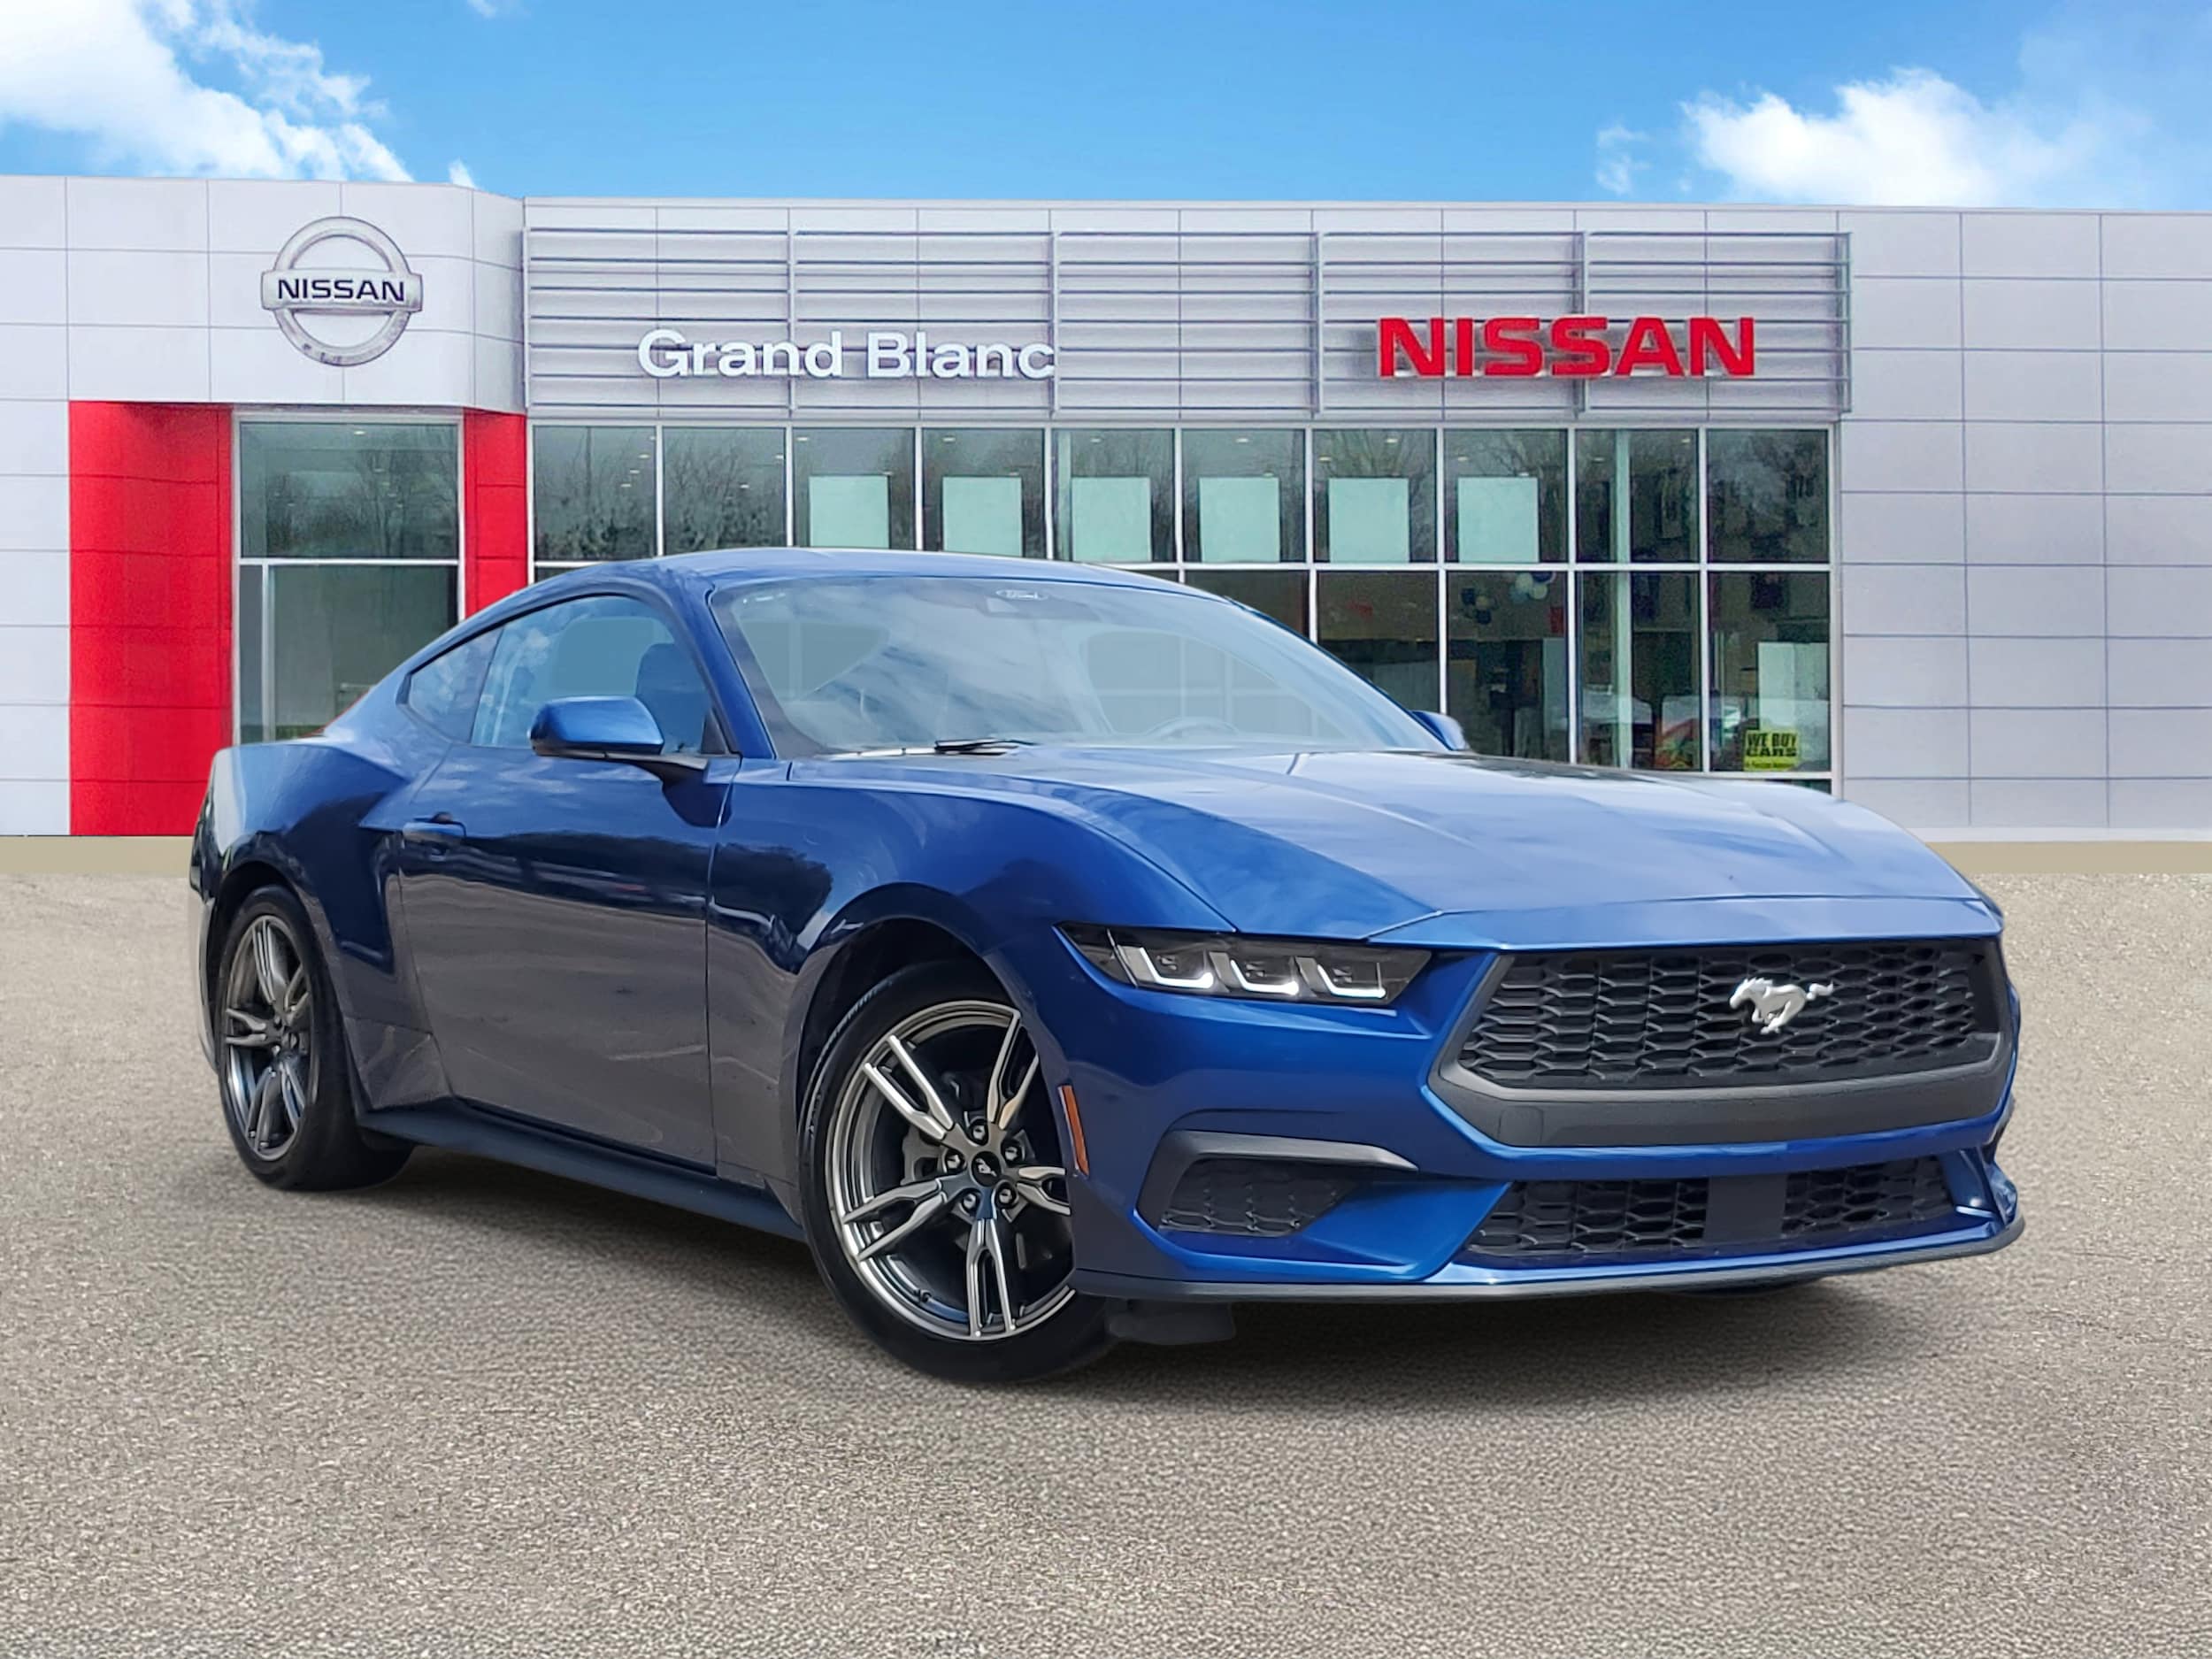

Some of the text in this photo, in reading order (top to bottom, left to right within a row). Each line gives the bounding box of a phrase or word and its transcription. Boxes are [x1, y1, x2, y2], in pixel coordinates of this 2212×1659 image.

[278, 279, 405, 302] NISSAN
[637, 328, 1056, 380] Grand Blanc
[1379, 316, 1756, 378] NISSAN
[1746, 747, 1797, 757] CARS
[1747, 733, 1797, 748] WE BUY
